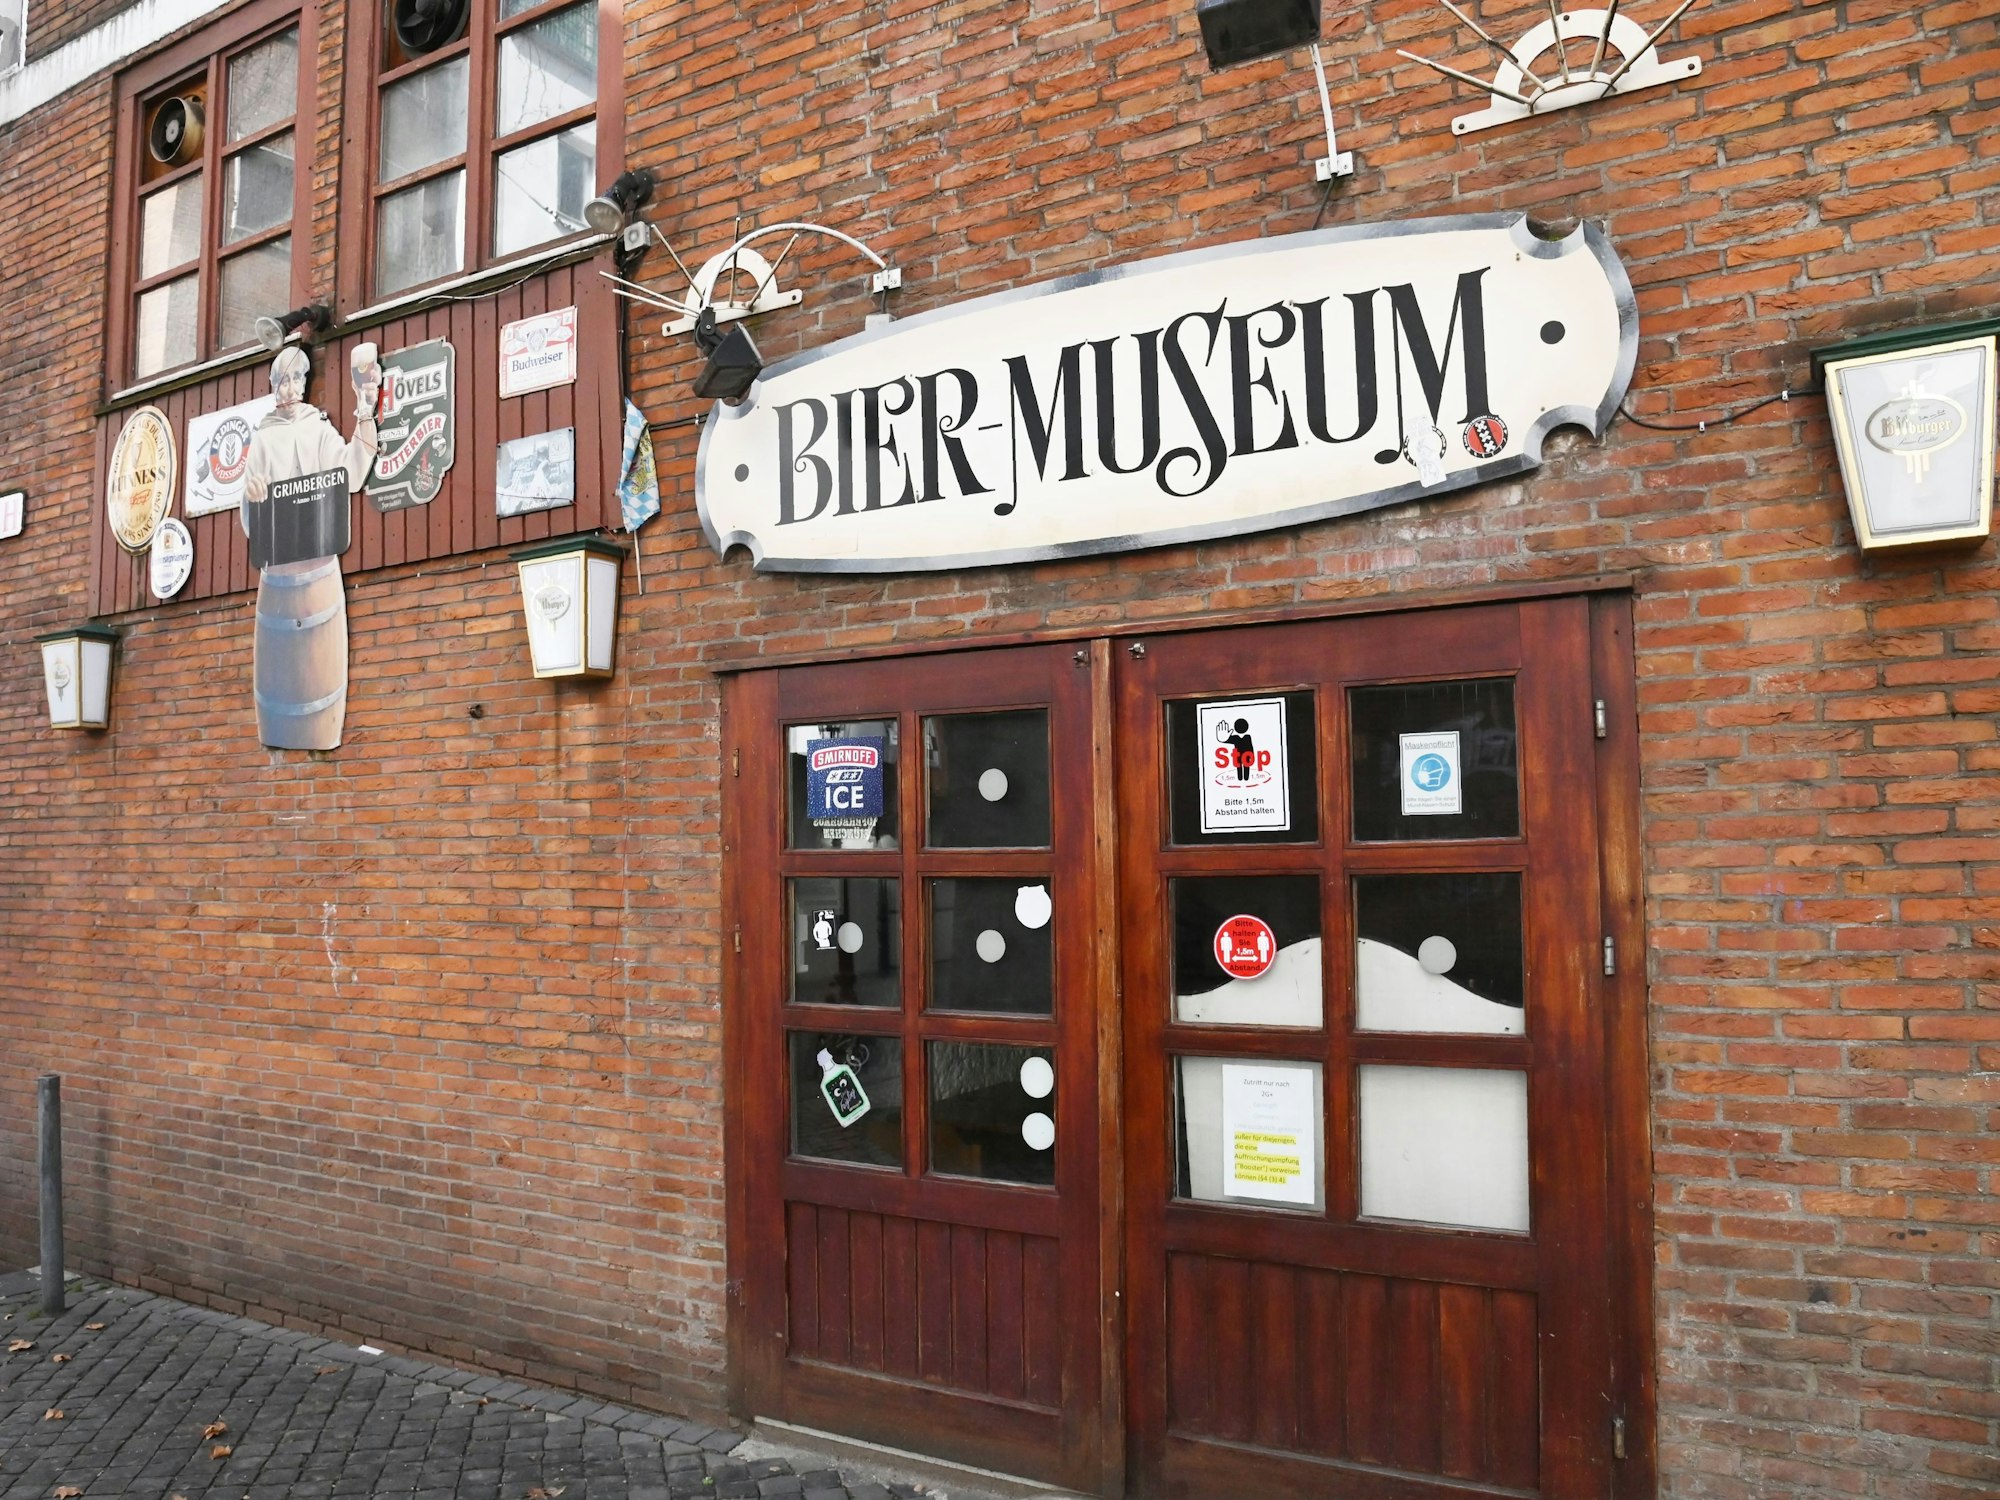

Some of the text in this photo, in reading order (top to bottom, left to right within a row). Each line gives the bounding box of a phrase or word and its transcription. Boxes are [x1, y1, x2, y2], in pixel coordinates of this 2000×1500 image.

[512, 351, 563, 373] Budweiser
[378, 371, 442, 425] HÖVELS
[772, 266, 1491, 526] BIER-MUSEUM
[213, 419, 250, 449] ERDINGER
[1881, 414, 1952, 438] Bitburger
[381, 416, 442, 475] BITTERBIER
[273, 470, 345, 499] GRIMBERGEN
[1215, 747, 1271, 771] Stop
[825, 786, 864, 809] ICE
[1224, 797, 1265, 806] Bitte 1,5m
[1215, 807, 1275, 816] Abstand halten
[1236, 947, 1254, 956] 1,5m
[1238, 938, 1251, 946] Sie
